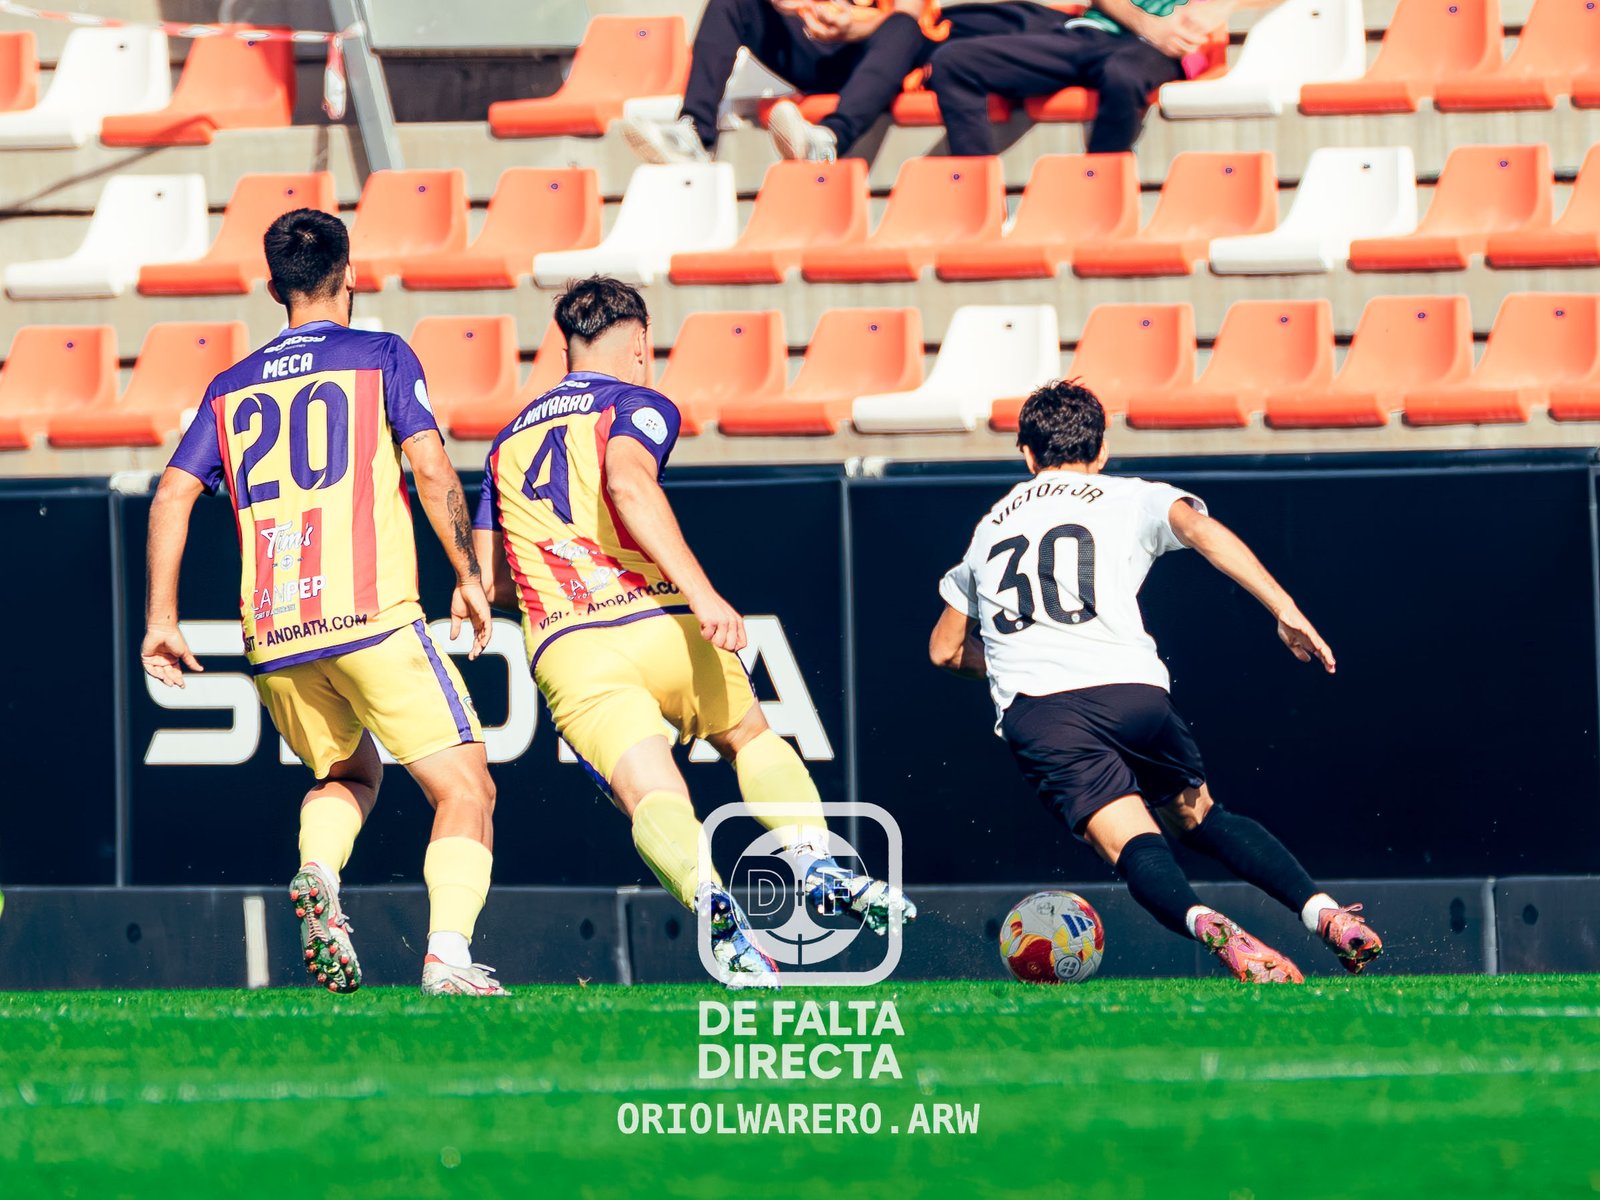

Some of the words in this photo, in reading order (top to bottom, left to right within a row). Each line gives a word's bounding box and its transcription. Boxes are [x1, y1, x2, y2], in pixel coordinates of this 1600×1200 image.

[262, 352, 313, 379] MECA
[233, 380, 349, 510] 20
[512, 393, 595, 433] L.NAVARRO
[521, 424, 574, 524] 4
[992, 482, 1069, 526] VICTOR
[1070, 482, 1104, 504] JR
[986, 523, 1098, 635] 30
